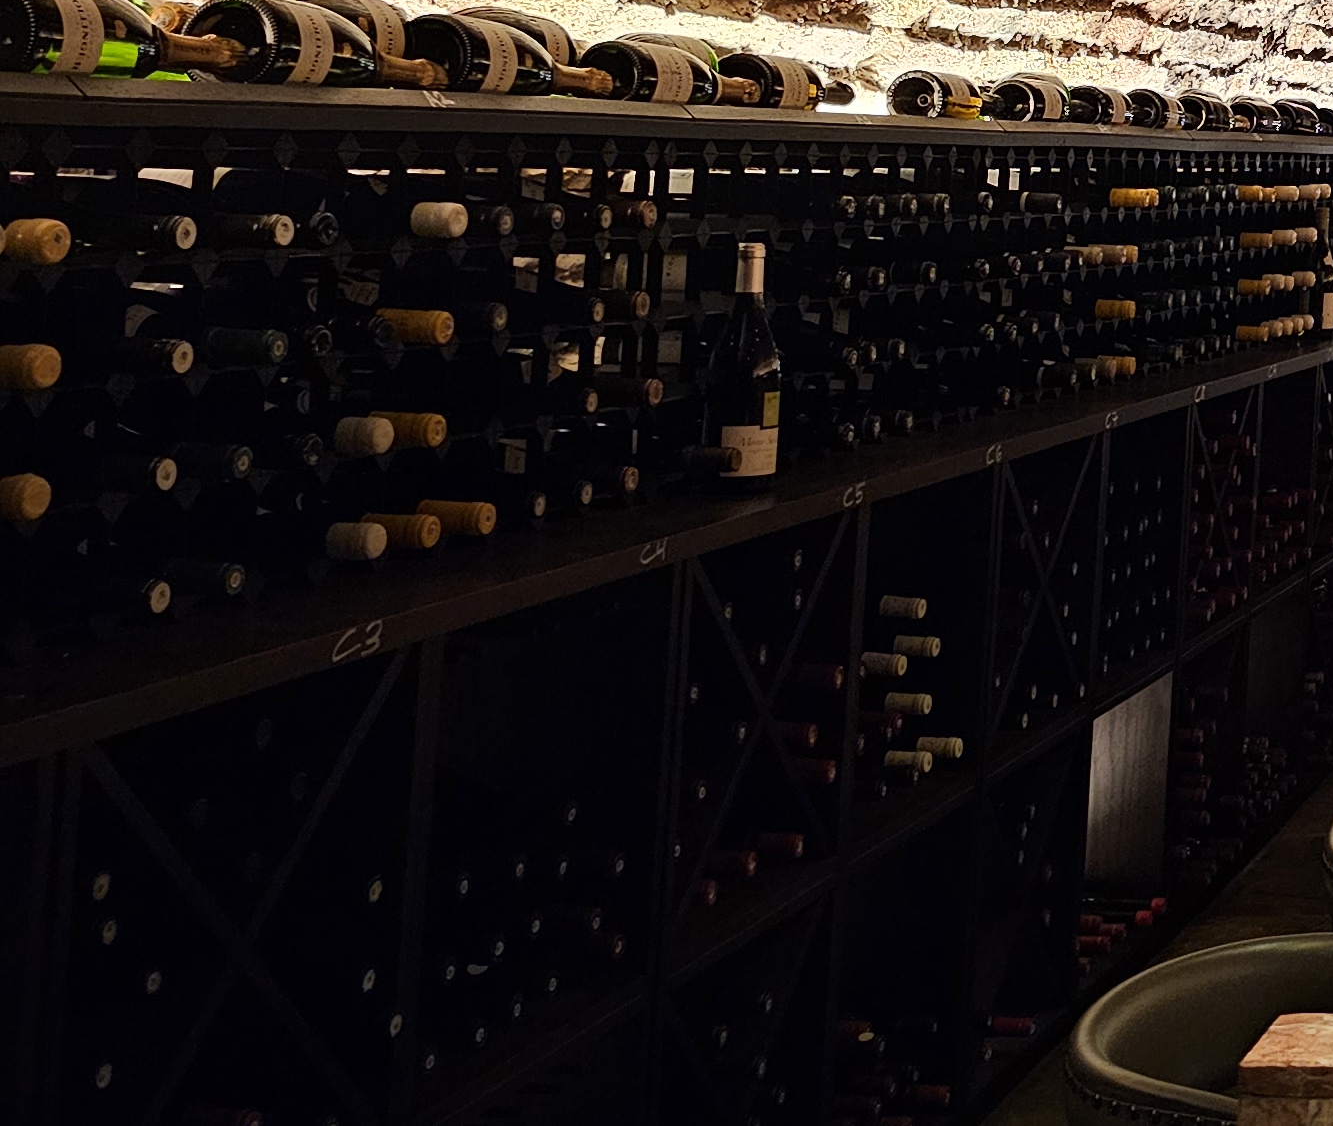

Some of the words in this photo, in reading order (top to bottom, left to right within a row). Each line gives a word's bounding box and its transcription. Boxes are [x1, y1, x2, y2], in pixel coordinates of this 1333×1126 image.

[842, 480, 867, 508] C5
[639, 536, 668, 566] C4
[331, 619, 384, 663] C3
